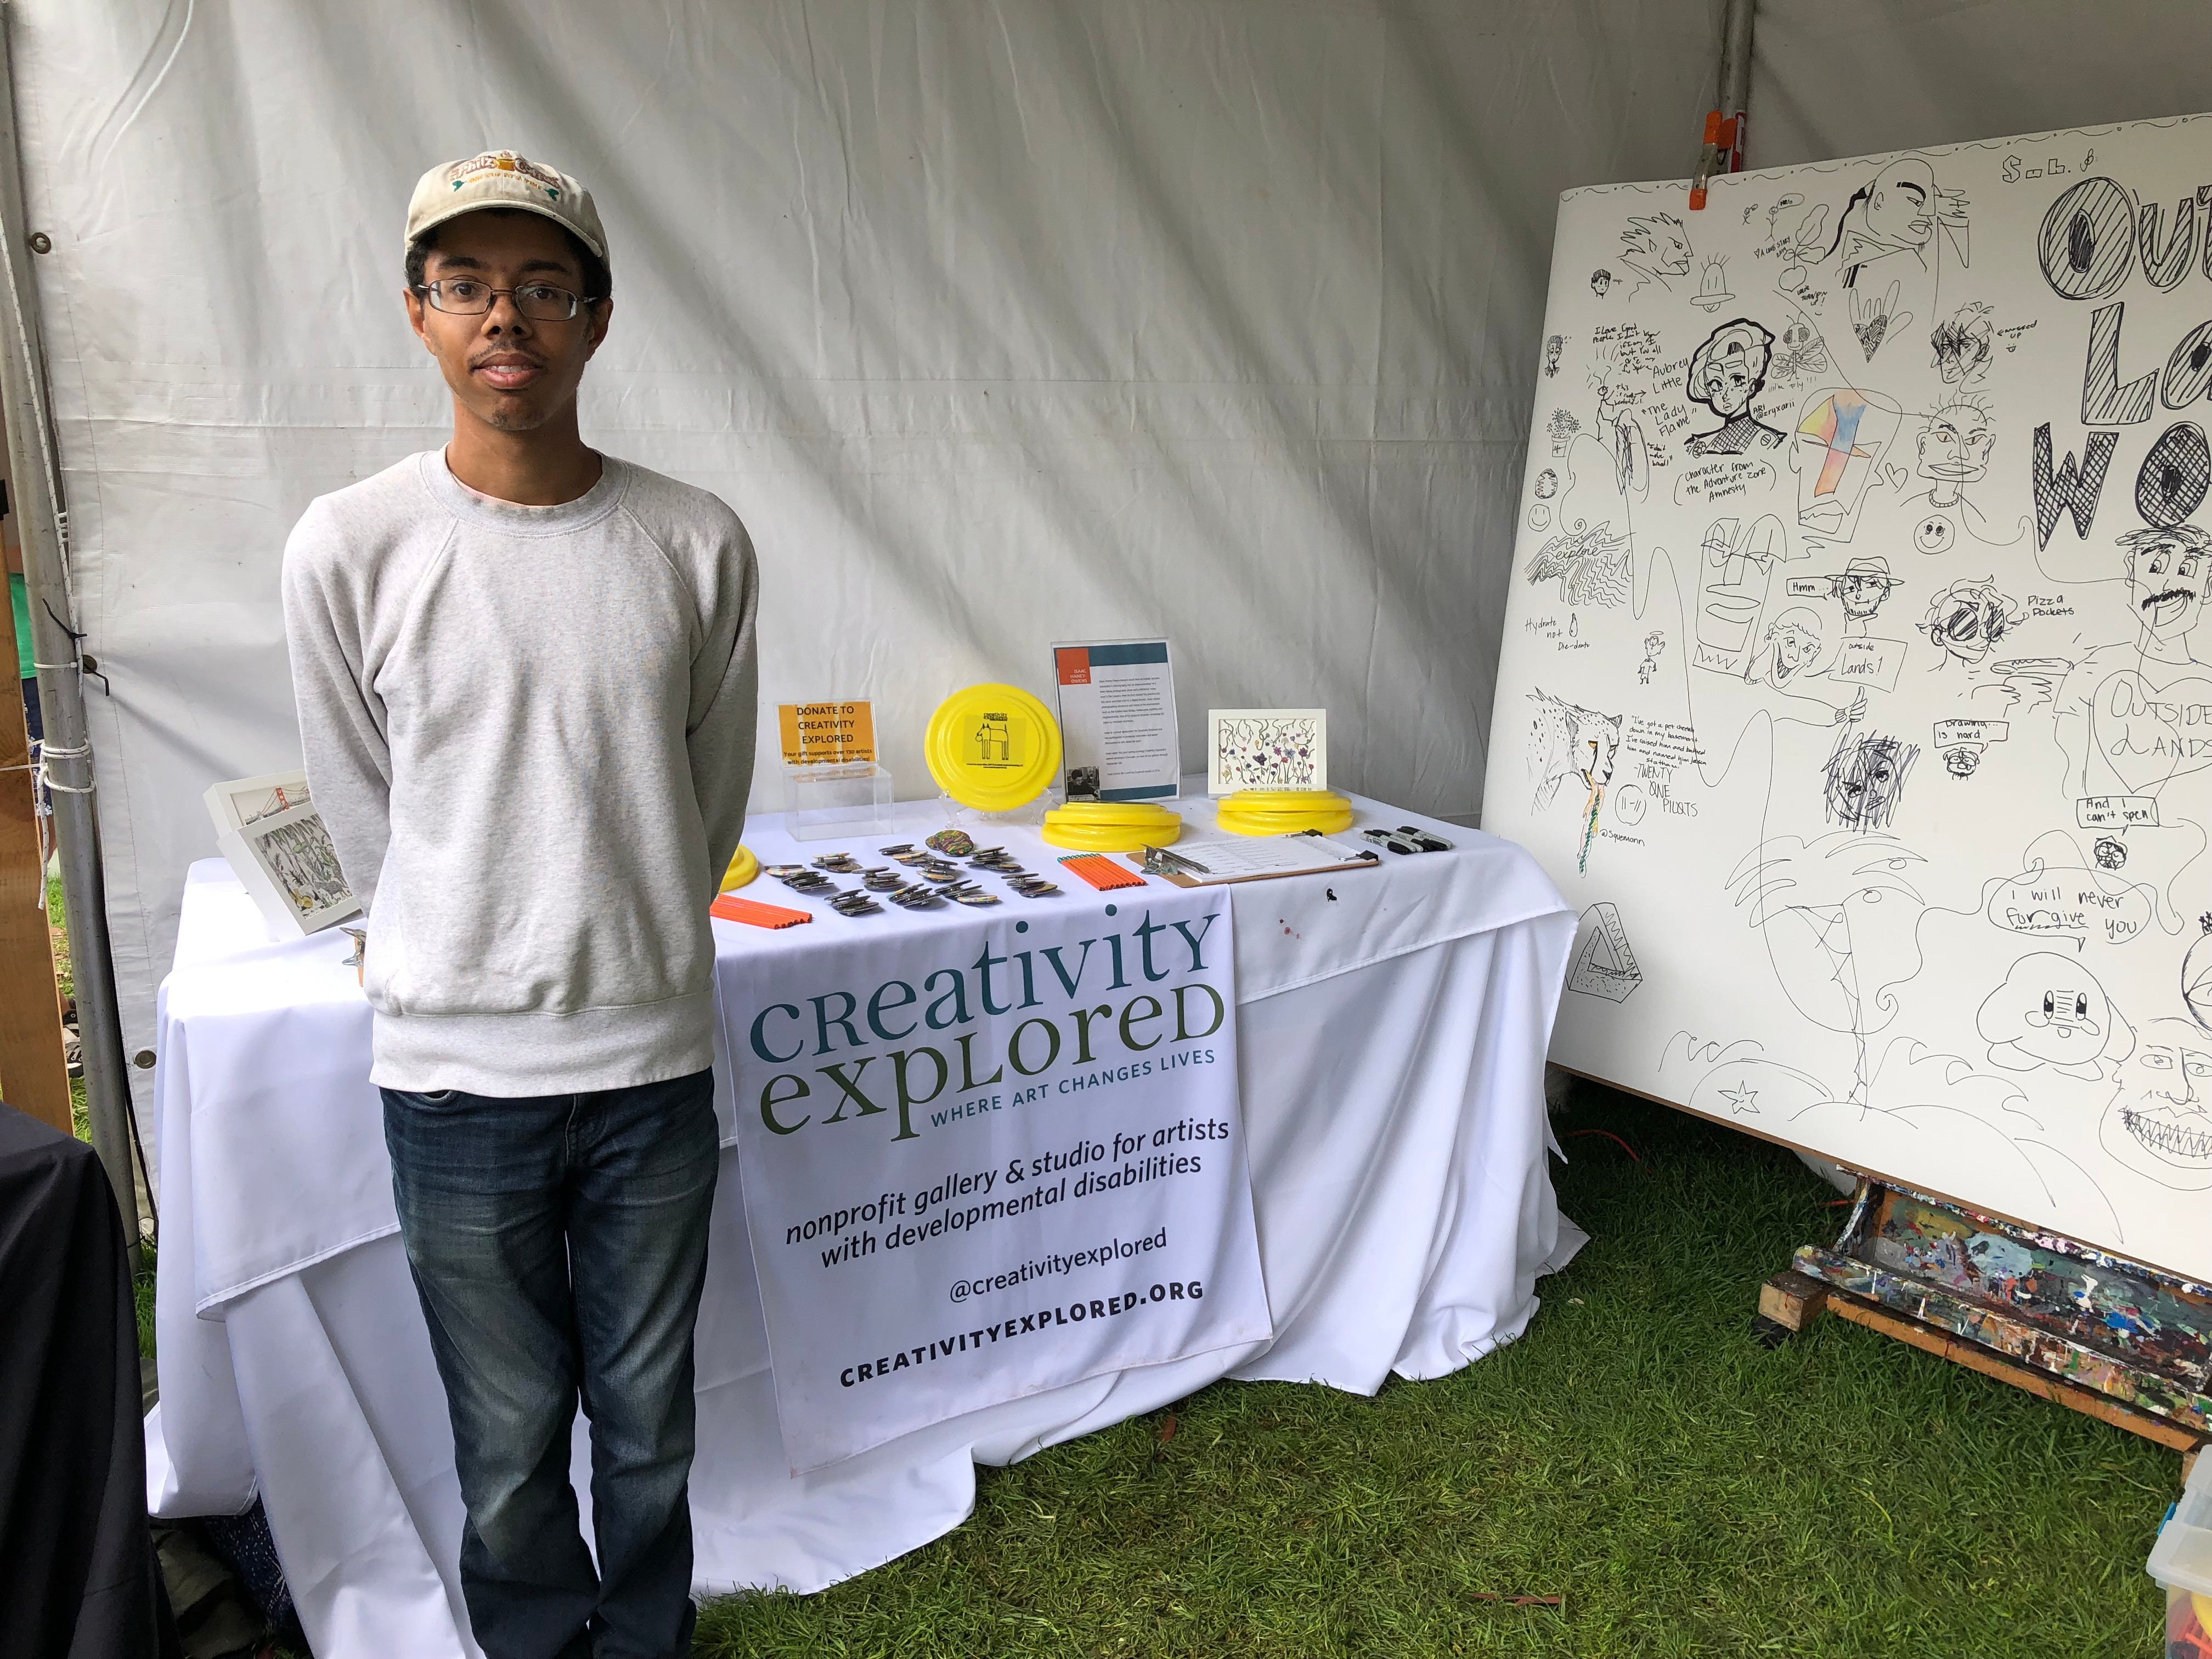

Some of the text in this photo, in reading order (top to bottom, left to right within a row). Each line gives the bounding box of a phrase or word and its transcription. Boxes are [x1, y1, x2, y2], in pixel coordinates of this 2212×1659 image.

[524, 178, 542, 190] TIME
[1653, 358, 1690, 379] Aubrey
[1652, 376, 1683, 394] Little
[1753, 404, 1765, 414] ARI
[1658, 416, 1690, 437] Flame
[1731, 461, 1754, 472] from
[1704, 472, 1743, 489] Adventure
[1709, 484, 1746, 503] Amnesty
[2028, 595, 2064, 606] Pizza
[1524, 616, 1557, 635] Hydrate
[1547, 628, 1563, 639] not
[797, 706, 854, 715] DONATE TO
[798, 720, 855, 730] CREATIVITY
[1646, 720, 1656, 729] got
[802, 734, 854, 744] EXPLORED
[1629, 726, 1645, 734] down
[1655, 731, 1666, 741] my
[1937, 730, 1948, 740] is
[1626, 734, 1638, 743] I've
[1639, 738, 1658, 747] raised
[1659, 741, 1672, 749] him
[1652, 751, 1676, 760] named
[2086, 797, 2126, 810] And I
[2086, 810, 2117, 822] can't
[2012, 886, 2124, 910] I will never
[930, 1048, 1216, 1128] WHERE ART CHANGES LIVES
[786, 1117, 1229, 1244] nonprofit gallery & studio for artists
[821, 1151, 1202, 1268] with developmental disabilities
[949, 1227, 1168, 1304] @creativityexplored
[840, 1281, 1204, 1388] CREATIVITYEXPLORED.ORG
